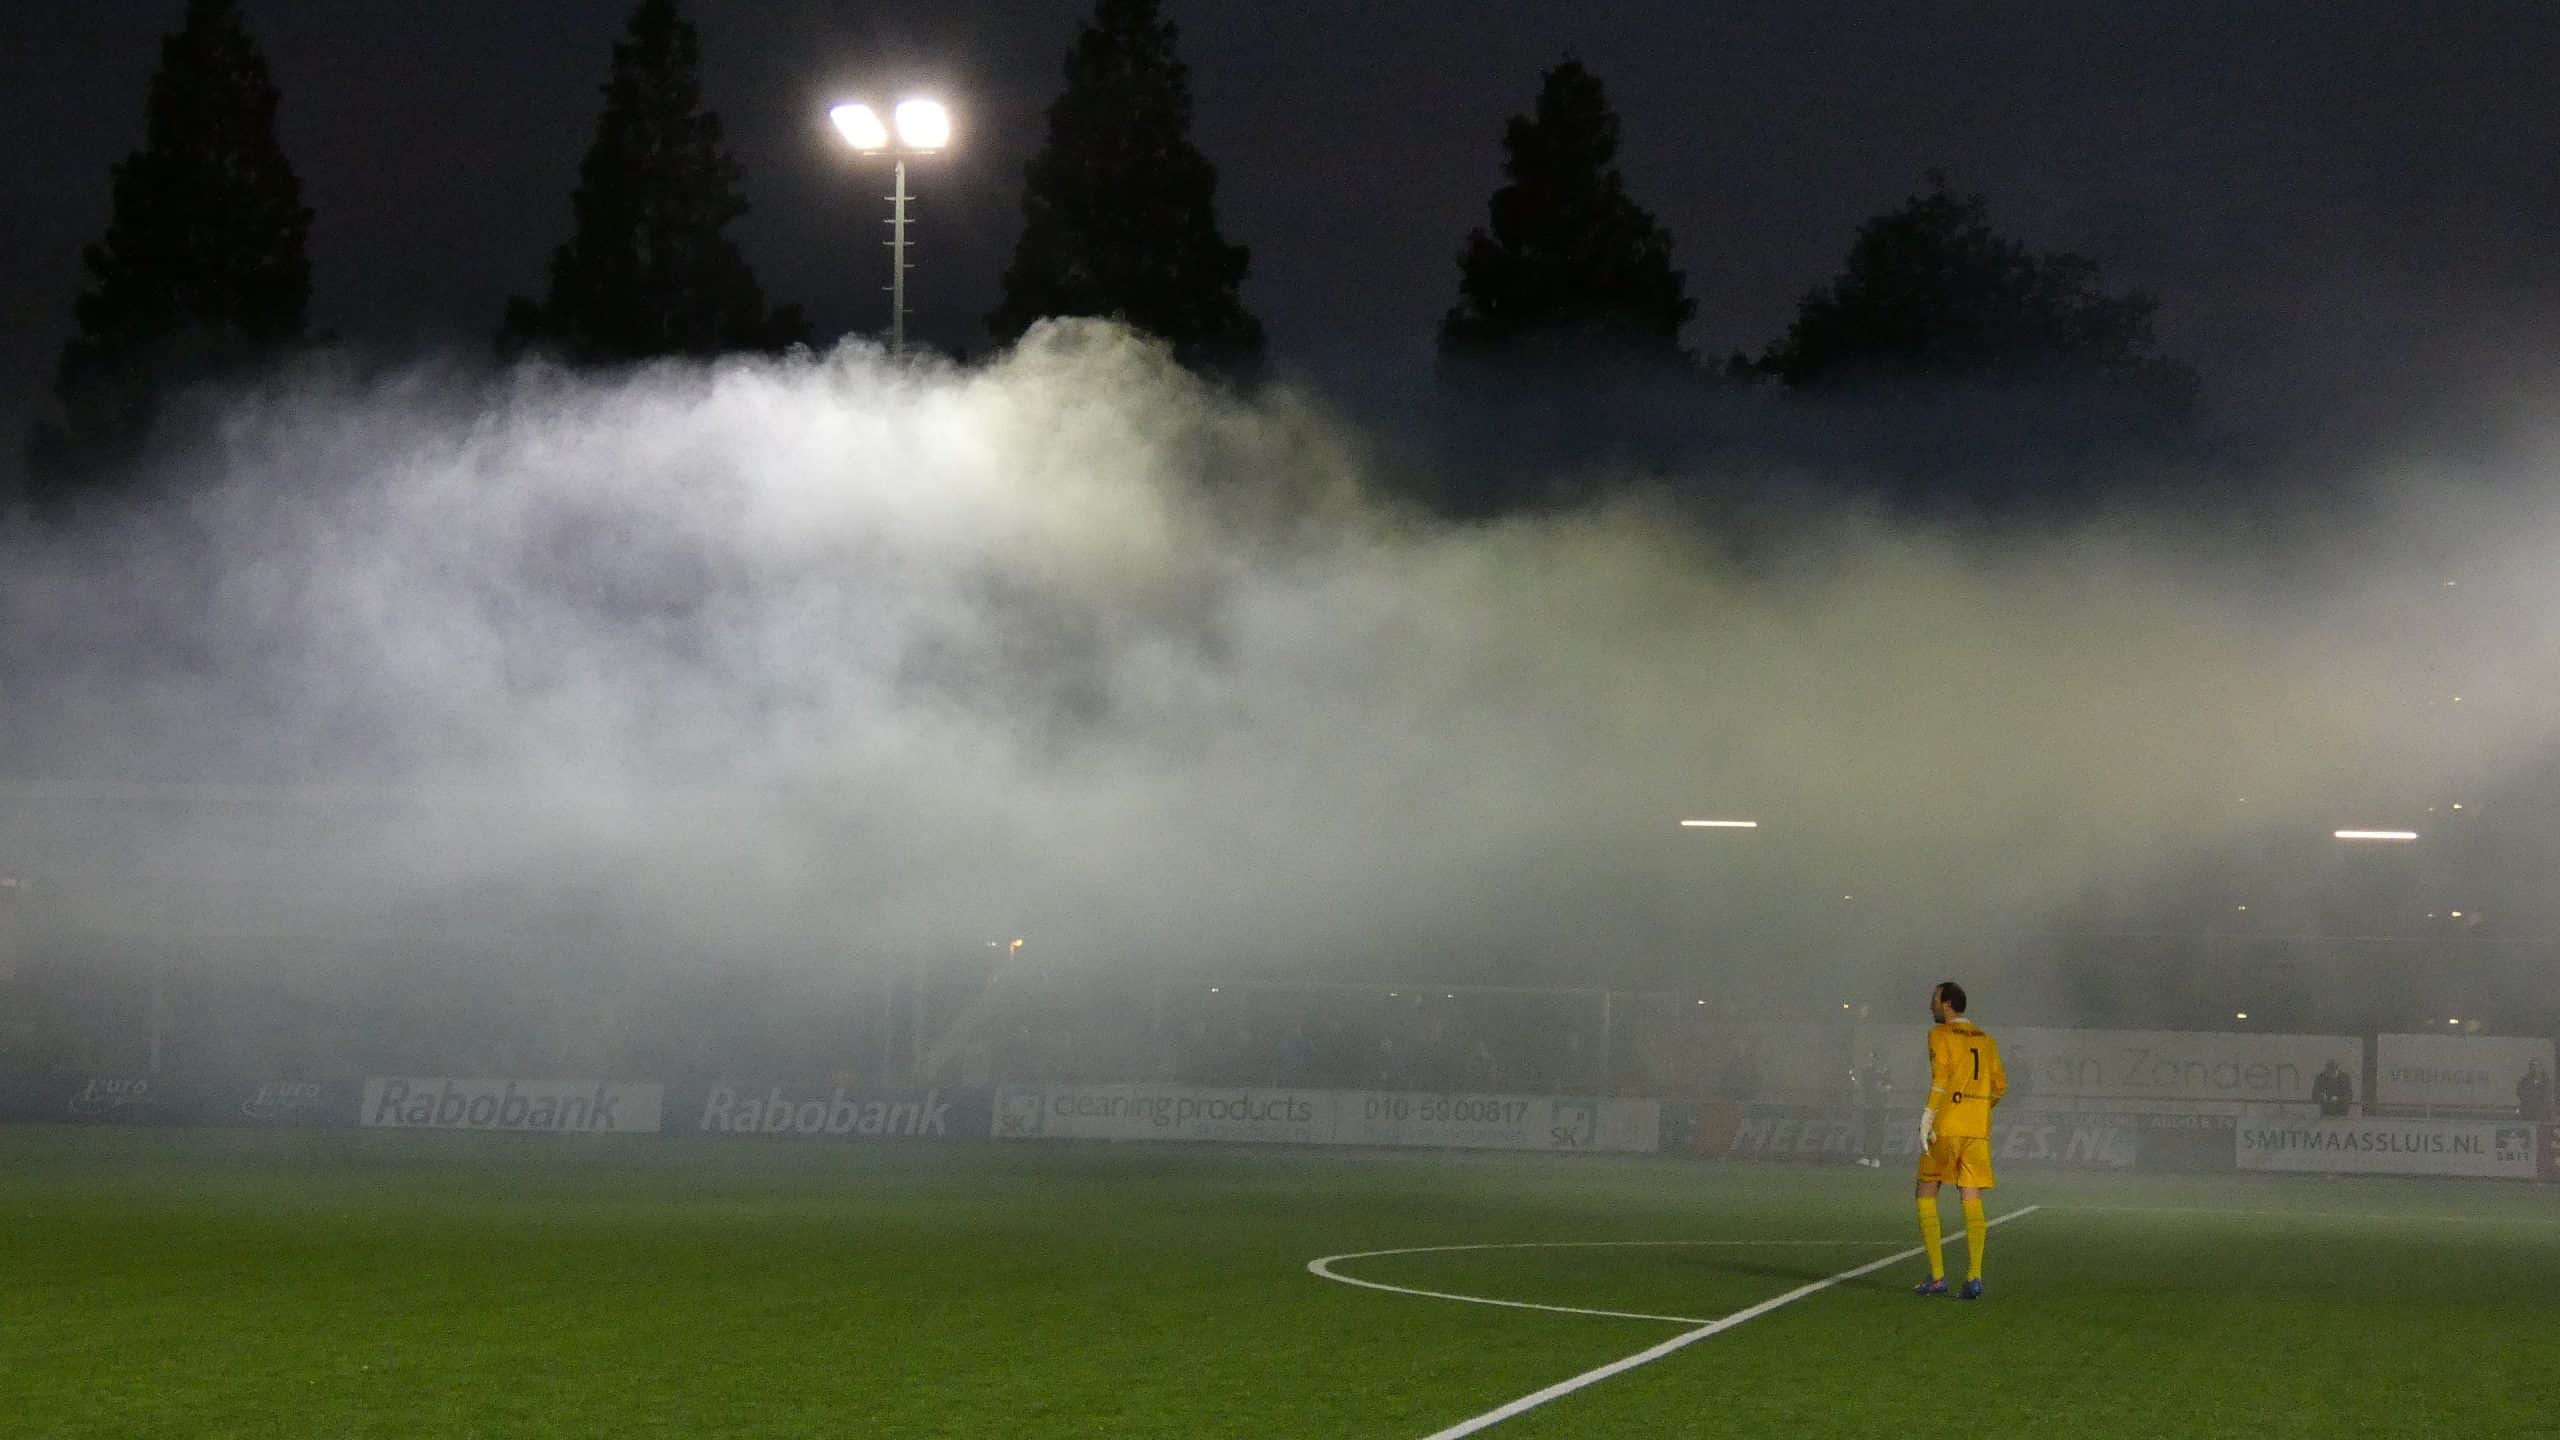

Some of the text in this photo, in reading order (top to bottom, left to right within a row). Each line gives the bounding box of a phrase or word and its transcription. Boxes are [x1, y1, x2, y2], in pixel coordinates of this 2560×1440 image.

[1969, 1047, 1979, 1081] 1
[374, 1077, 622, 1130] Rabobank
[699, 1086, 950, 1136] Rabobank
[2241, 1127, 2486, 1155] SMITMAASSLUIS.NL
